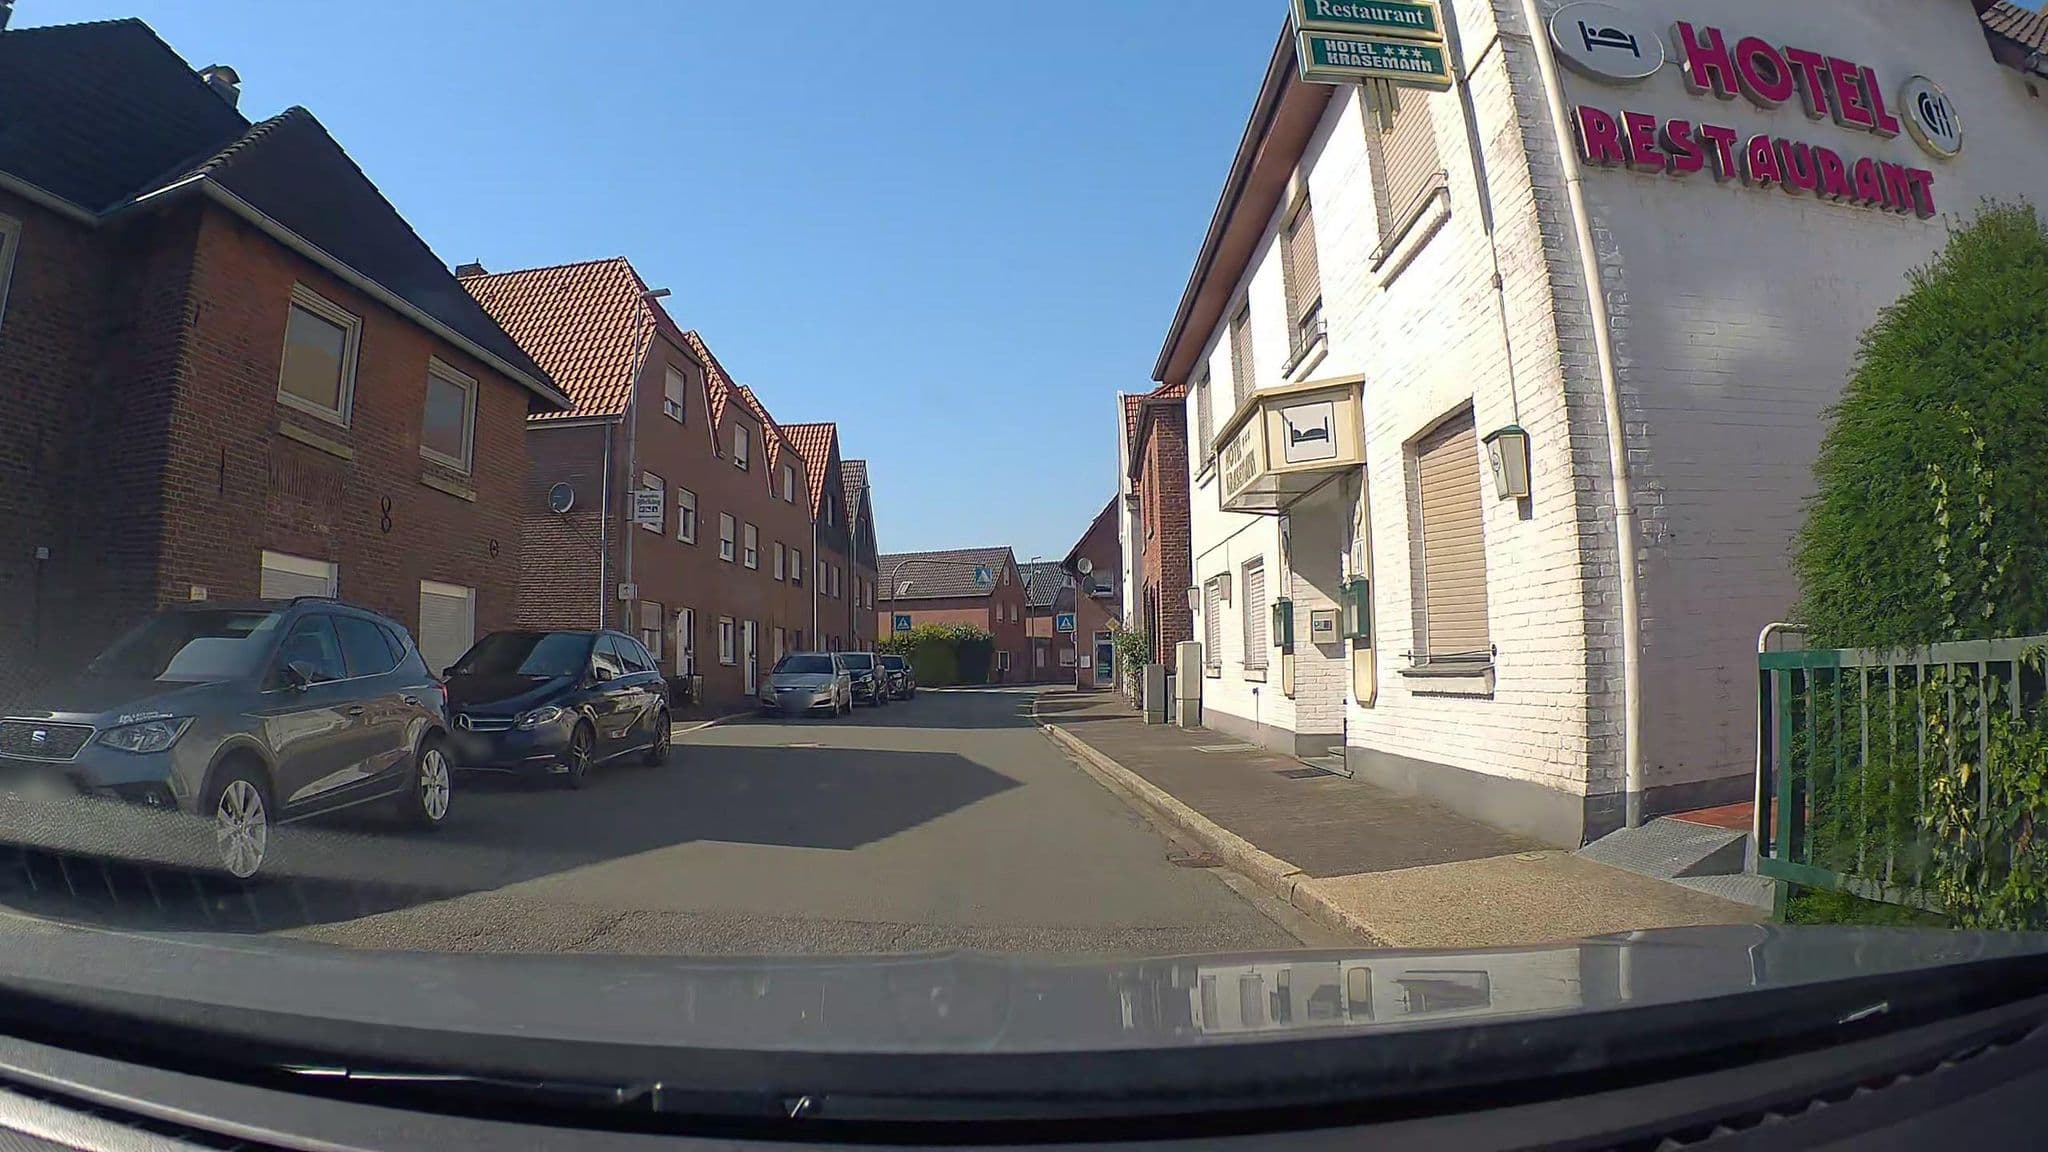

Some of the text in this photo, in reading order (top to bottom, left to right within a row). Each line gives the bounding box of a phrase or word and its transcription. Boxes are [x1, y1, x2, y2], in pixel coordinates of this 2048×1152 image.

[1316, 0, 1425, 25] Restaurant
[1324, 39, 1377, 55] HOTEL
[1326, 51, 1433, 73] KRASEMANN
[1675, 20, 1900, 138] HOTEL
[1575, 105, 1936, 219] RESTAURANT
